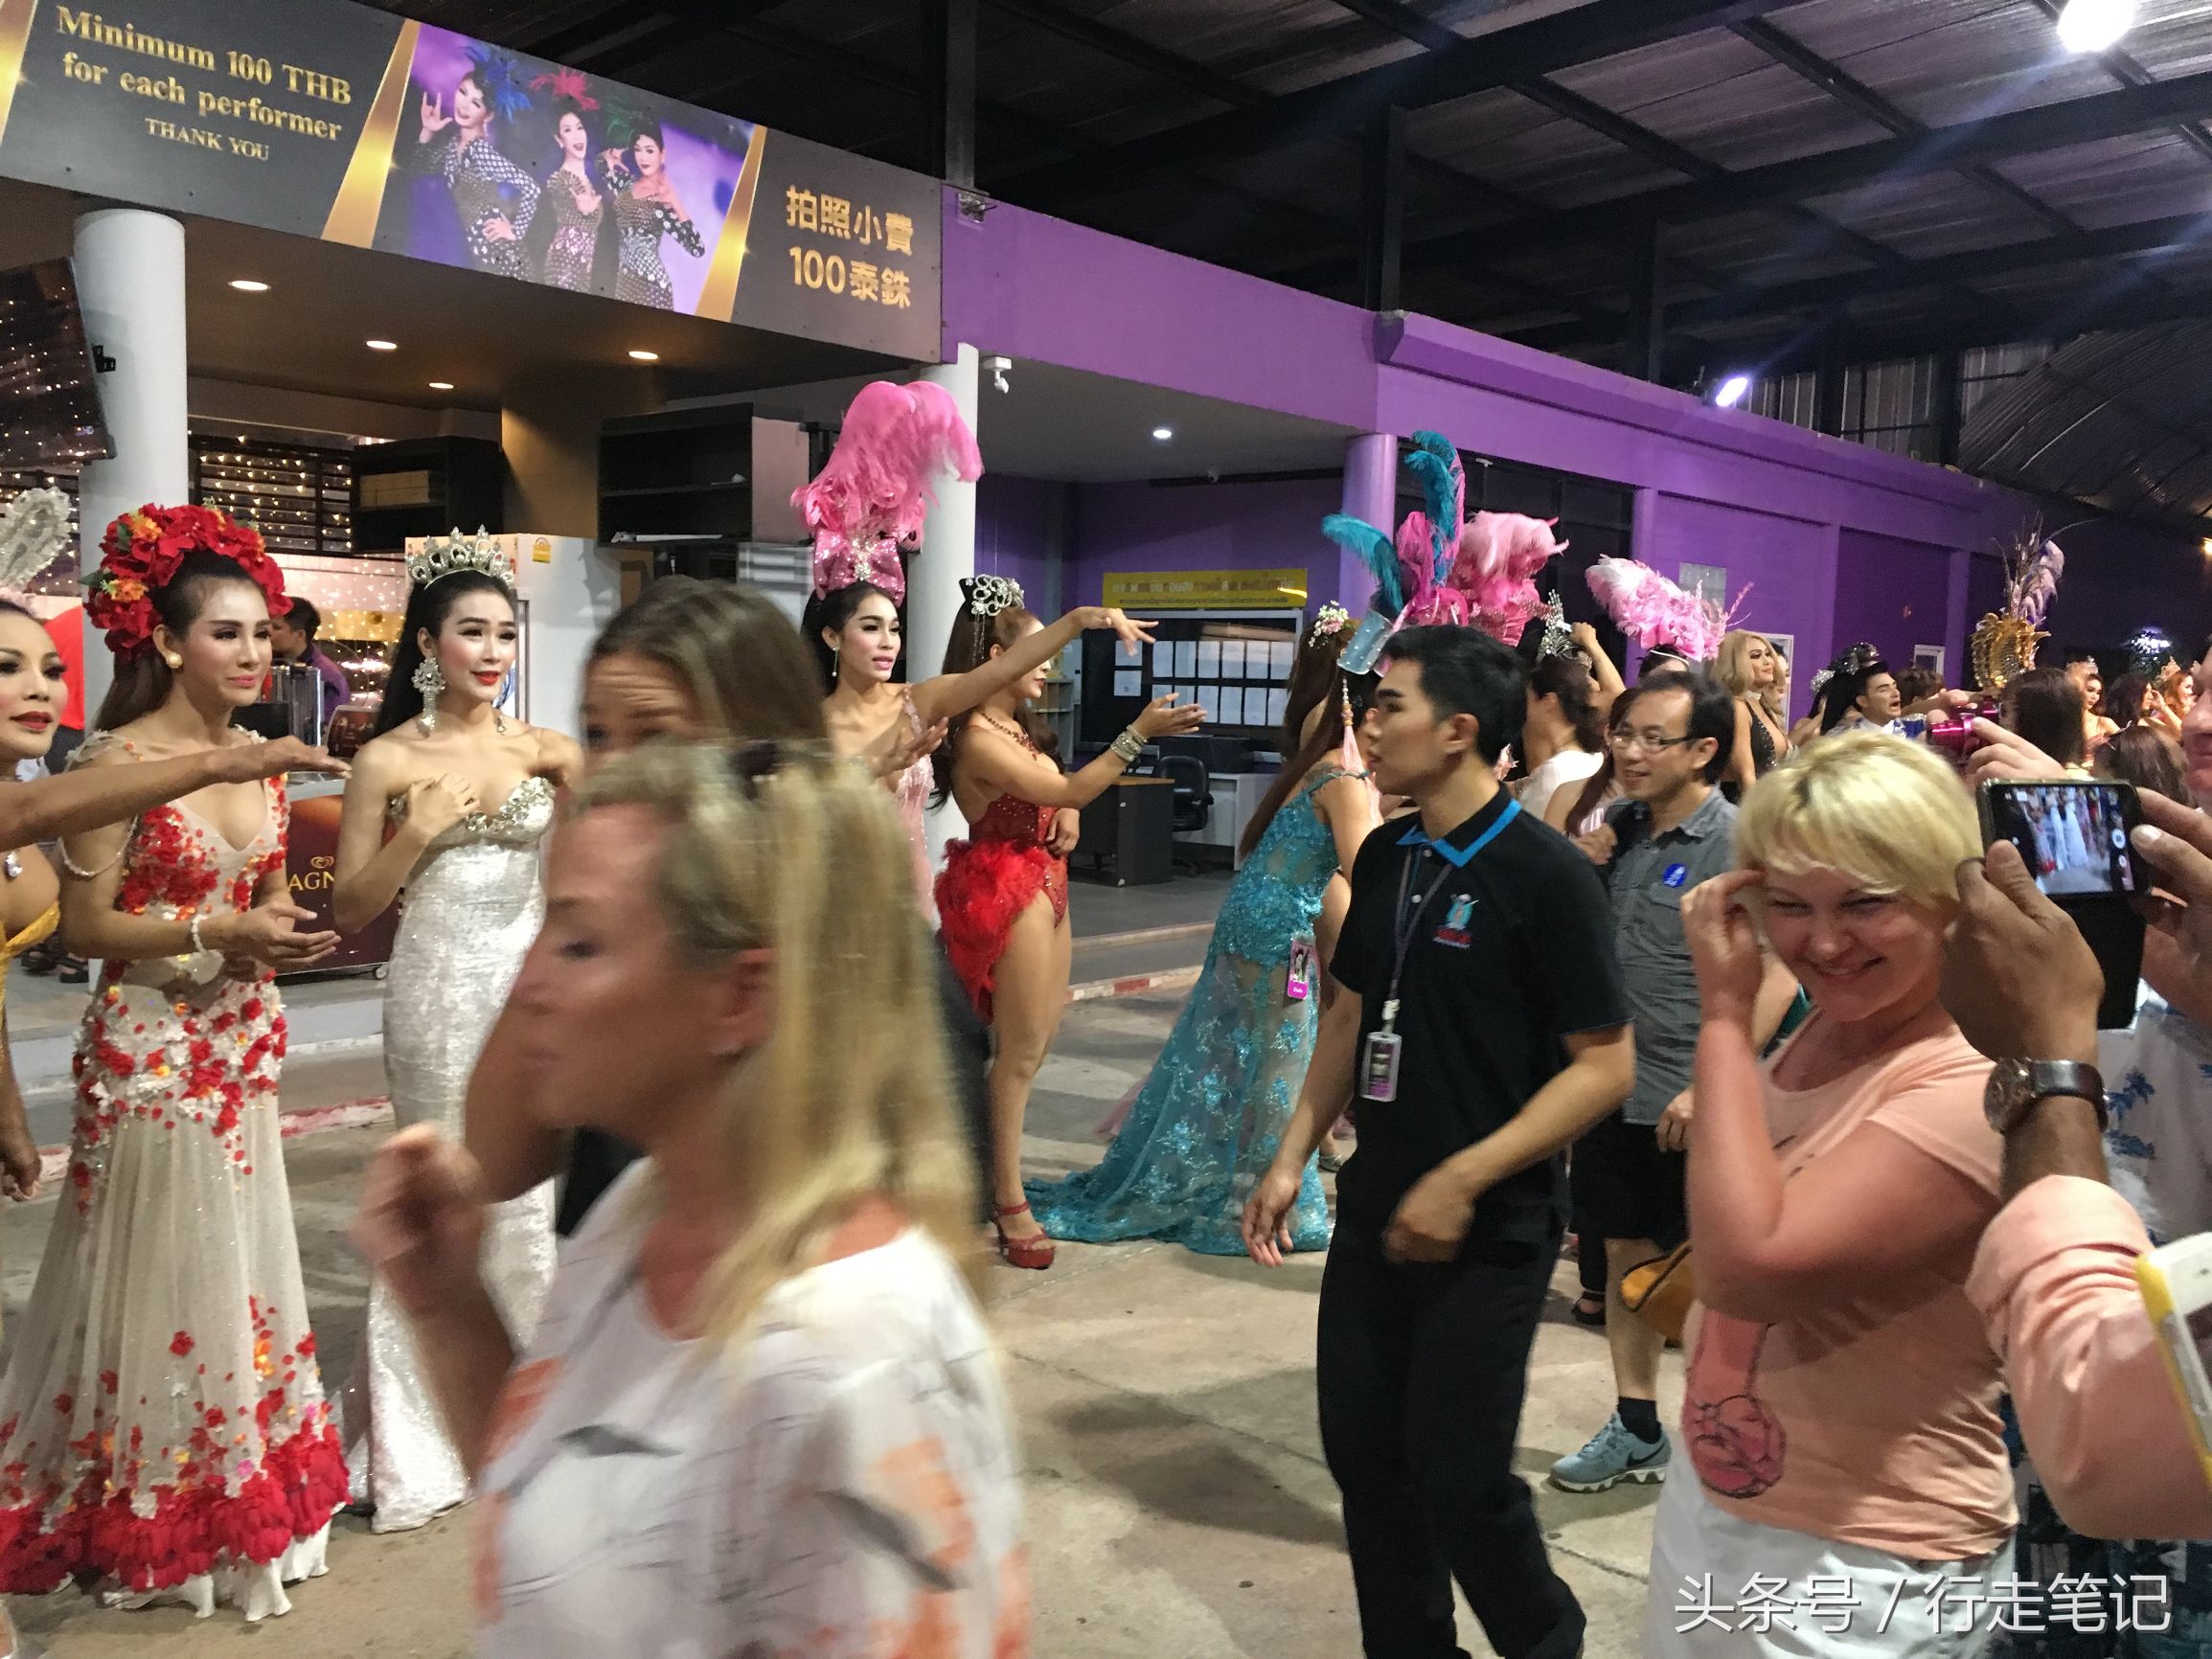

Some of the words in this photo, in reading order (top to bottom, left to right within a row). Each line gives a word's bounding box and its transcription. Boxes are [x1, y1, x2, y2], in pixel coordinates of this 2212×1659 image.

[56, 5, 216, 72] Minimum
[226, 51, 272, 85] 100
[282, 63, 352, 105] THB
[62, 51, 108, 84] for
[120, 72, 186, 105] each
[197, 90, 343, 141] performer
[145, 117, 223, 151] THANK
[228, 136, 271, 162] YOU
